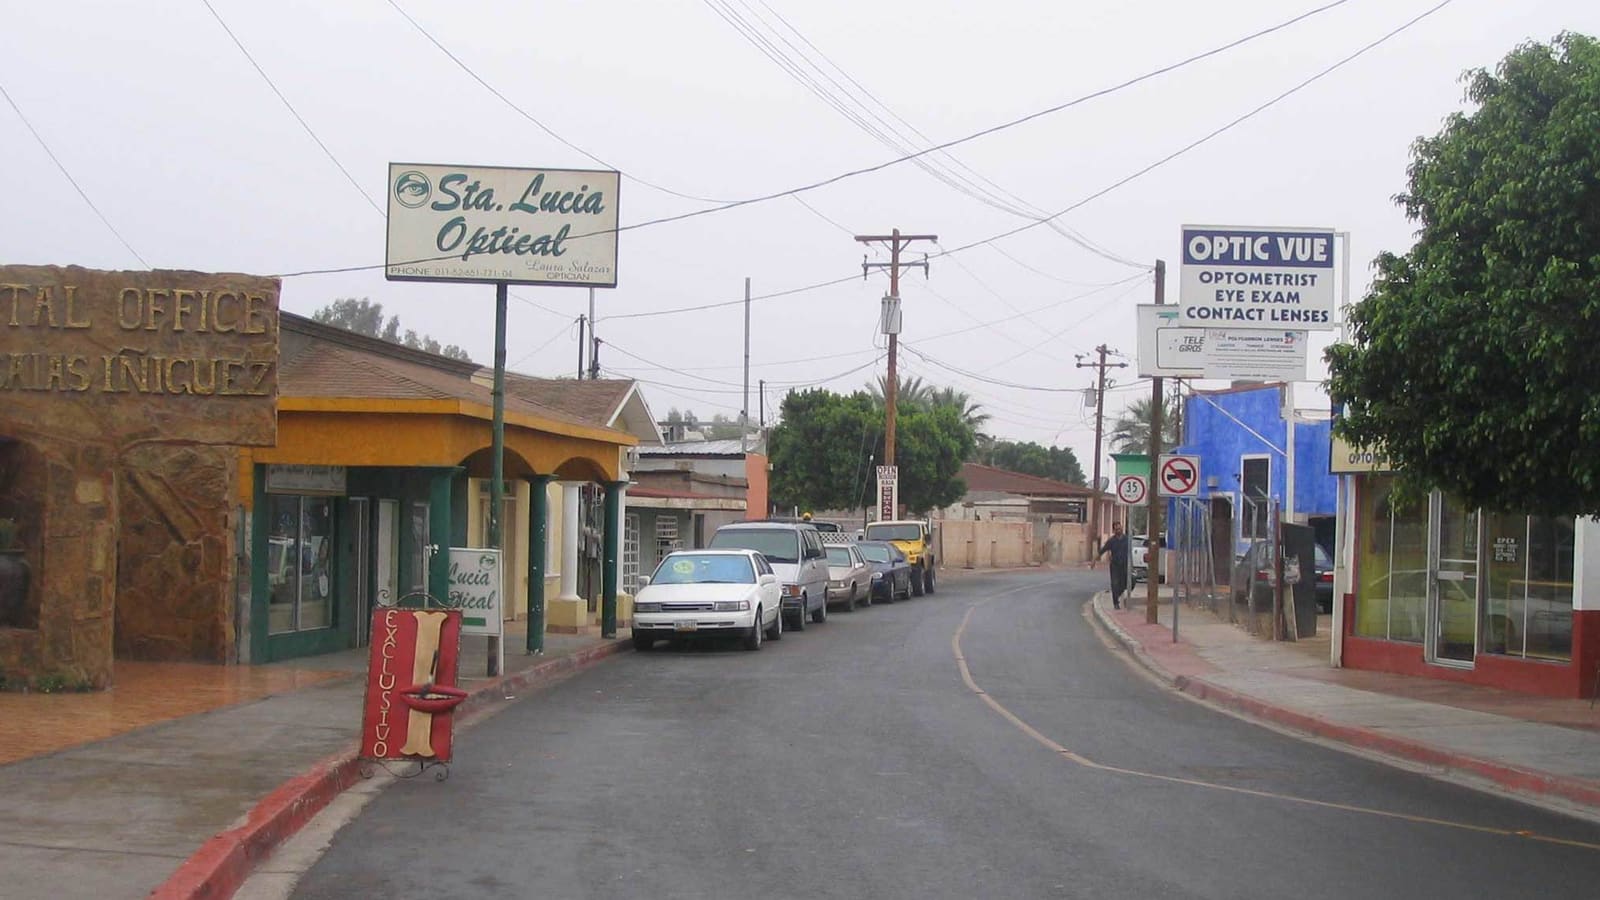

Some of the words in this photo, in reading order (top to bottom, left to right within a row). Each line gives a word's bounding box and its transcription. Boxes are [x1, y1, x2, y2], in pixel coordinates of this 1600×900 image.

[431, 173, 503, 212] Sta.
[509, 173, 606, 215] Lucia
[436, 216, 571, 261] Optical
[1188, 235, 1269, 261] OPTIC
[1276, 237, 1327, 262] VUE
[390, 266, 431, 275] PHONE
[546, 272, 590, 280] OPTICIAN
[1199, 271, 1318, 287] OPTOMETRIST
[1215, 290, 1245, 303] EYE
[1251, 290, 1300, 304] EXAM
[118, 287, 267, 334] OFFICE
[1186, 306, 1265, 321] CONTACT
[1271, 309, 1329, 323] LENSES
[1126, 481, 1138, 493] 35
[373, 610, 398, 758] EXCLUSIVO
